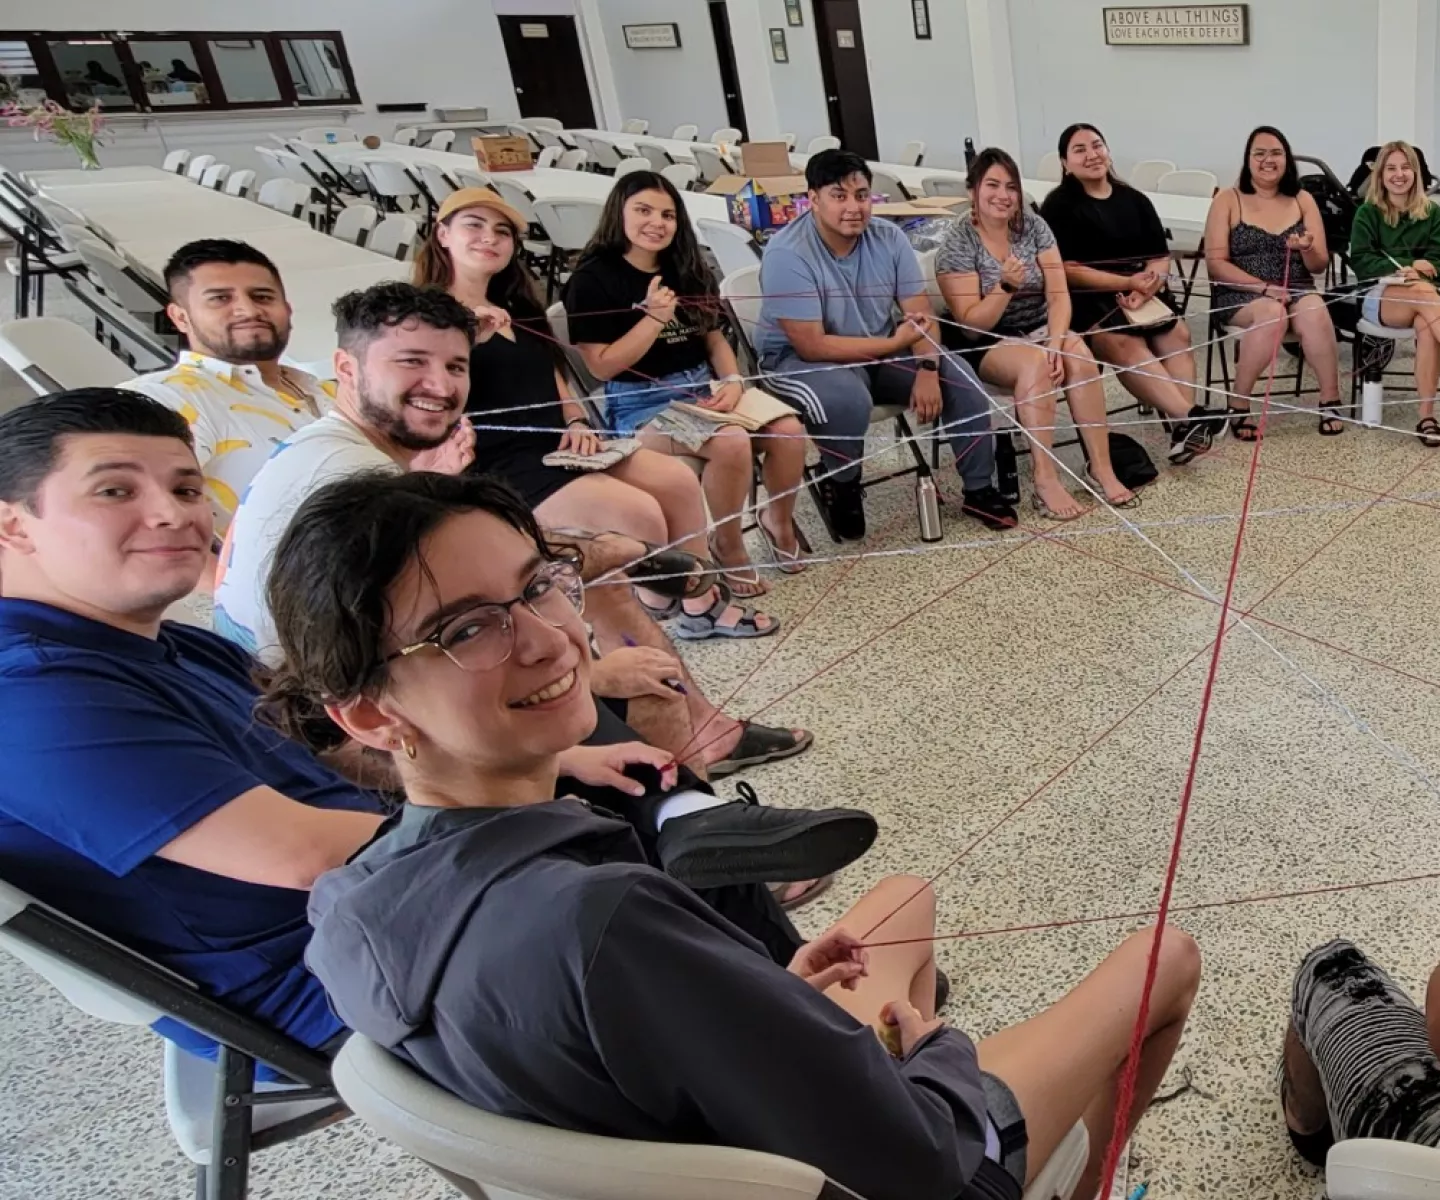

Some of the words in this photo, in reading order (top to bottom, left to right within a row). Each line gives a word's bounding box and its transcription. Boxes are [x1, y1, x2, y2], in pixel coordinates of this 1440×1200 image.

[1109, 11, 1150, 24] ABOVE
[1156, 10, 1180, 24] ALL
[1185, 9, 1239, 23] THINGS
[1111, 28, 1133, 39] LOVE
[1135, 28, 1160, 38] EACH
[1163, 27, 1195, 38] OTHER
[1199, 27, 1239, 38] DEEPLY
